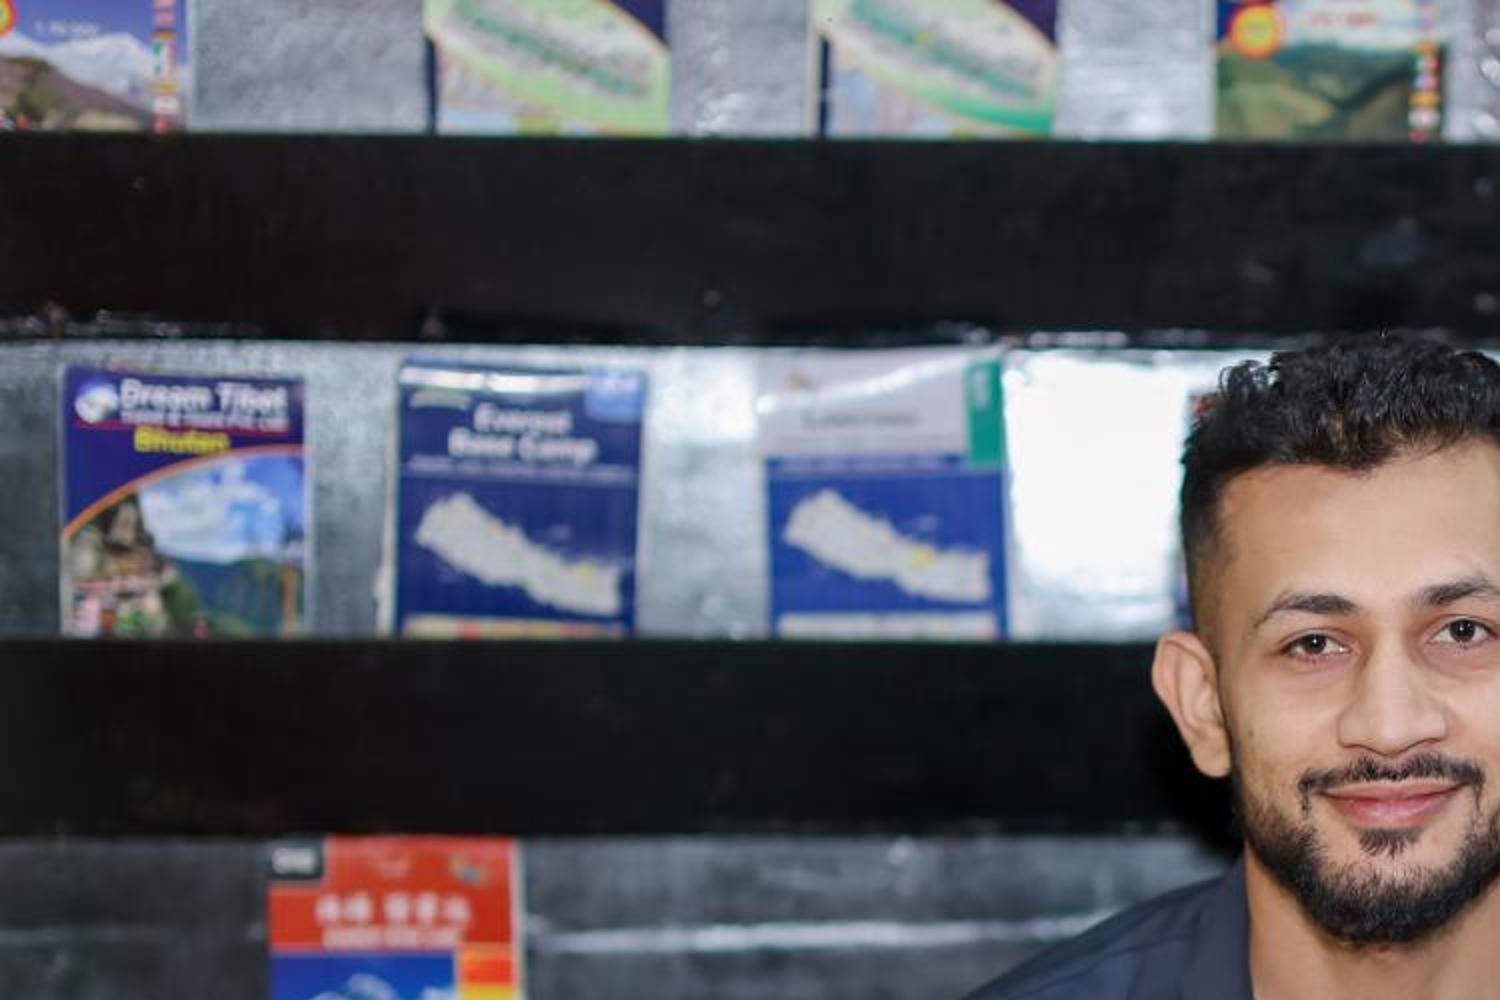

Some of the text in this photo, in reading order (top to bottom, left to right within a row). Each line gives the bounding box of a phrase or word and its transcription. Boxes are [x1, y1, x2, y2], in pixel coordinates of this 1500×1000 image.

[120, 378, 288, 415] Dream Tibet
[134, 426, 230, 453] Bhutan
[518, 430, 598, 468] Camp
